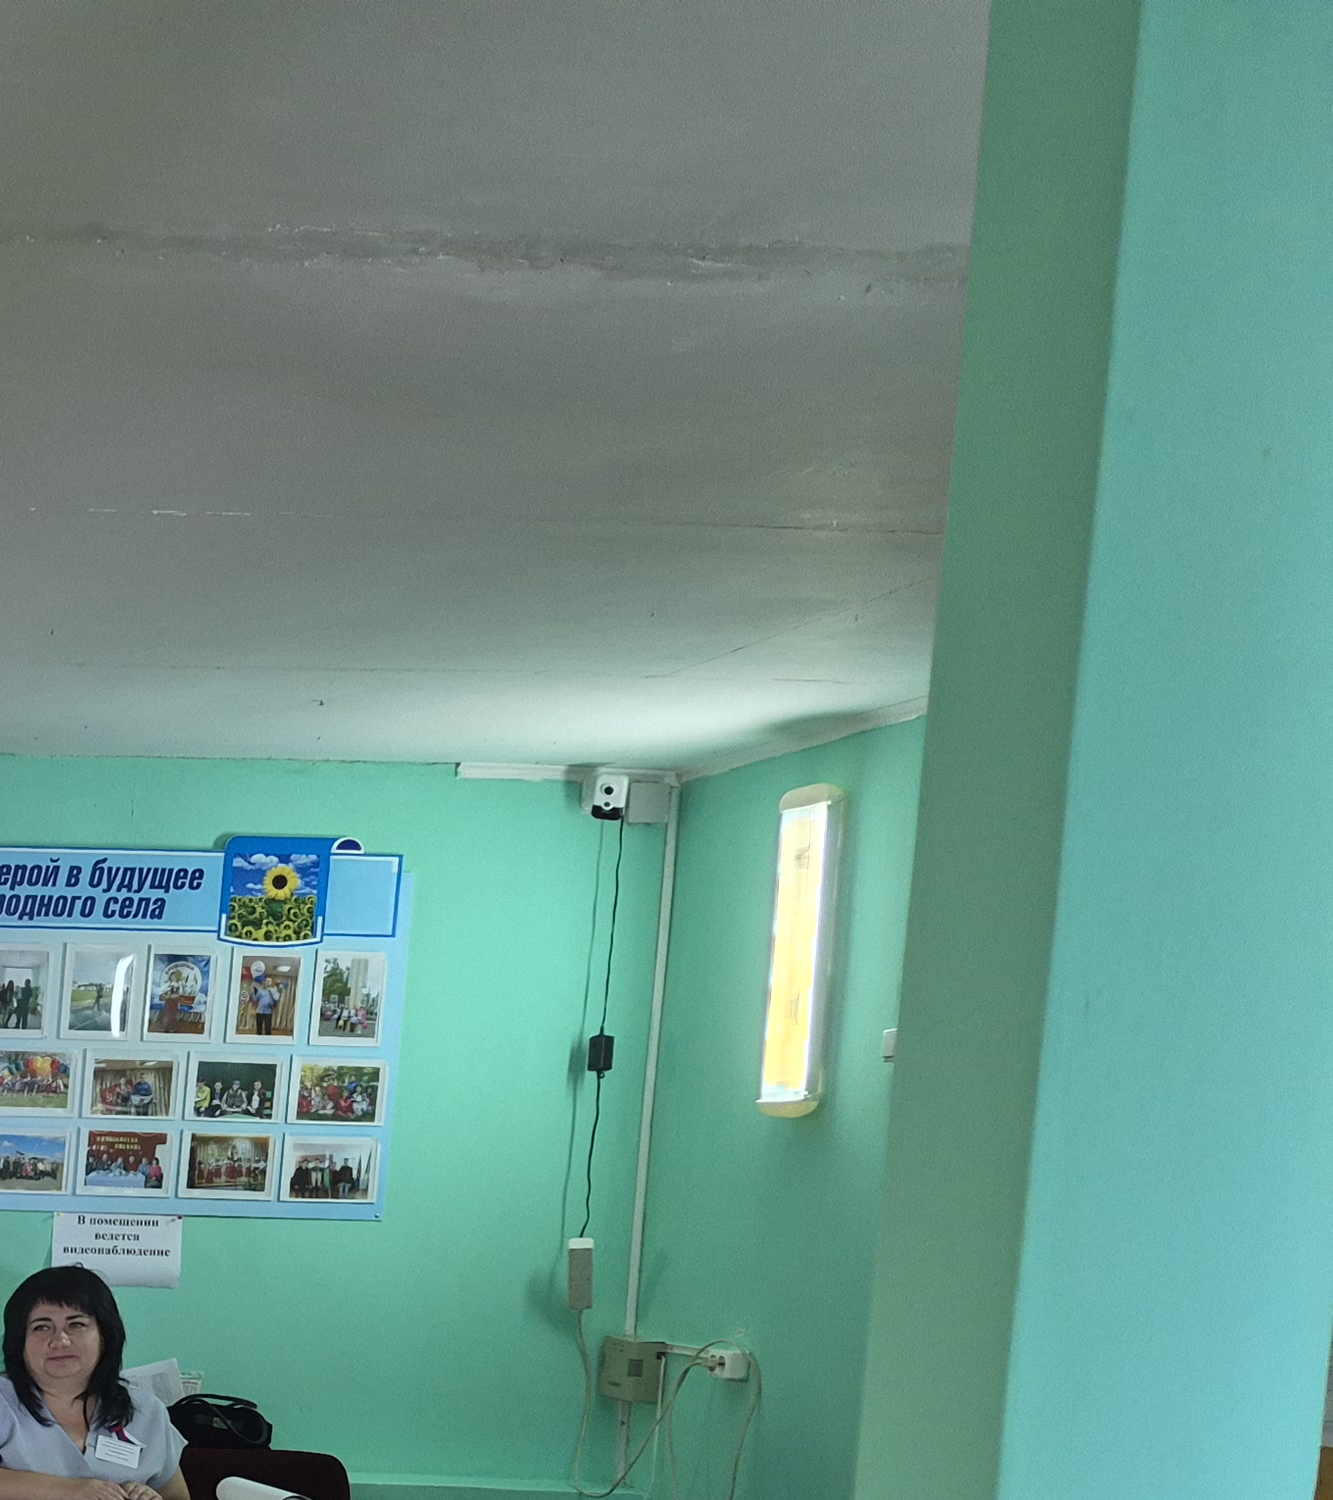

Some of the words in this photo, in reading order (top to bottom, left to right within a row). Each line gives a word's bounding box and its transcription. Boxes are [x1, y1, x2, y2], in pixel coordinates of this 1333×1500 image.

[65, 865, 82, 888] в
[88, 857, 205, 893] будущее
[102, 897, 167, 920] села
[77, 1215, 86, 1226] В
[89, 1217, 159, 1228] помещении
[94, 1232, 140, 1242] ведется
[63, 1246, 170, 1257] видеонаблюдение
